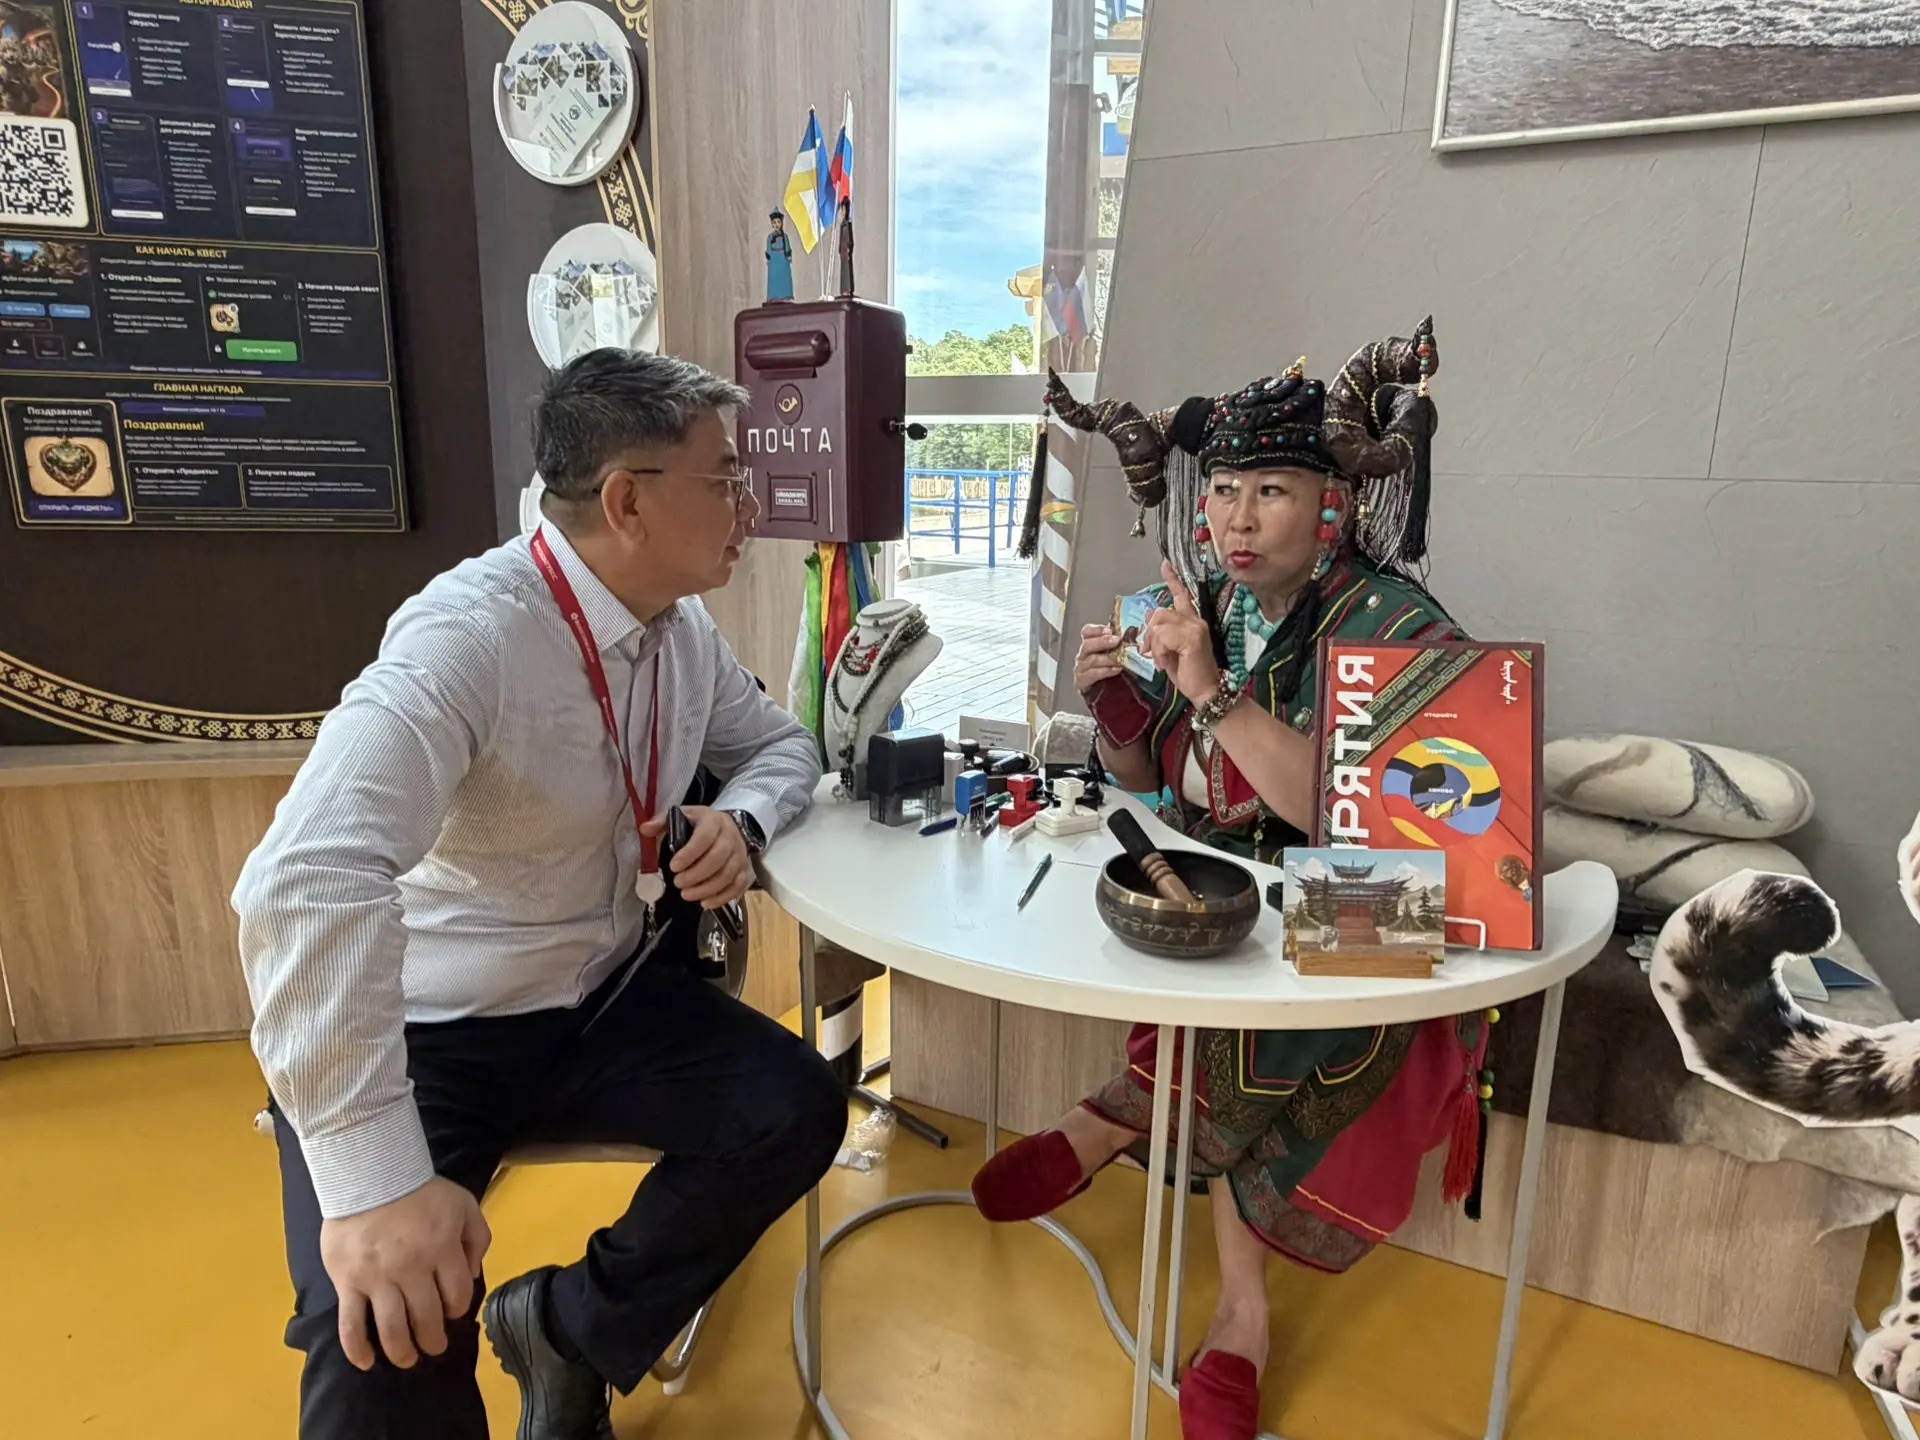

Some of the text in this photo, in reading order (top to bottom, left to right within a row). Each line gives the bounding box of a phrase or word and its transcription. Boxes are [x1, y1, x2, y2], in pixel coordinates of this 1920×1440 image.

[135, 245, 228, 258] КАК НАЧАТЬ КВЕСТ
[108, 273, 142, 281] Откройте
[153, 383, 244, 394] ГЛАВНАЯ НАГРАДА
[27, 406, 93, 417] Поздравляем!
[123, 419, 205, 432] Поздравляем!
[747, 427, 832, 453] ПОЧТА
